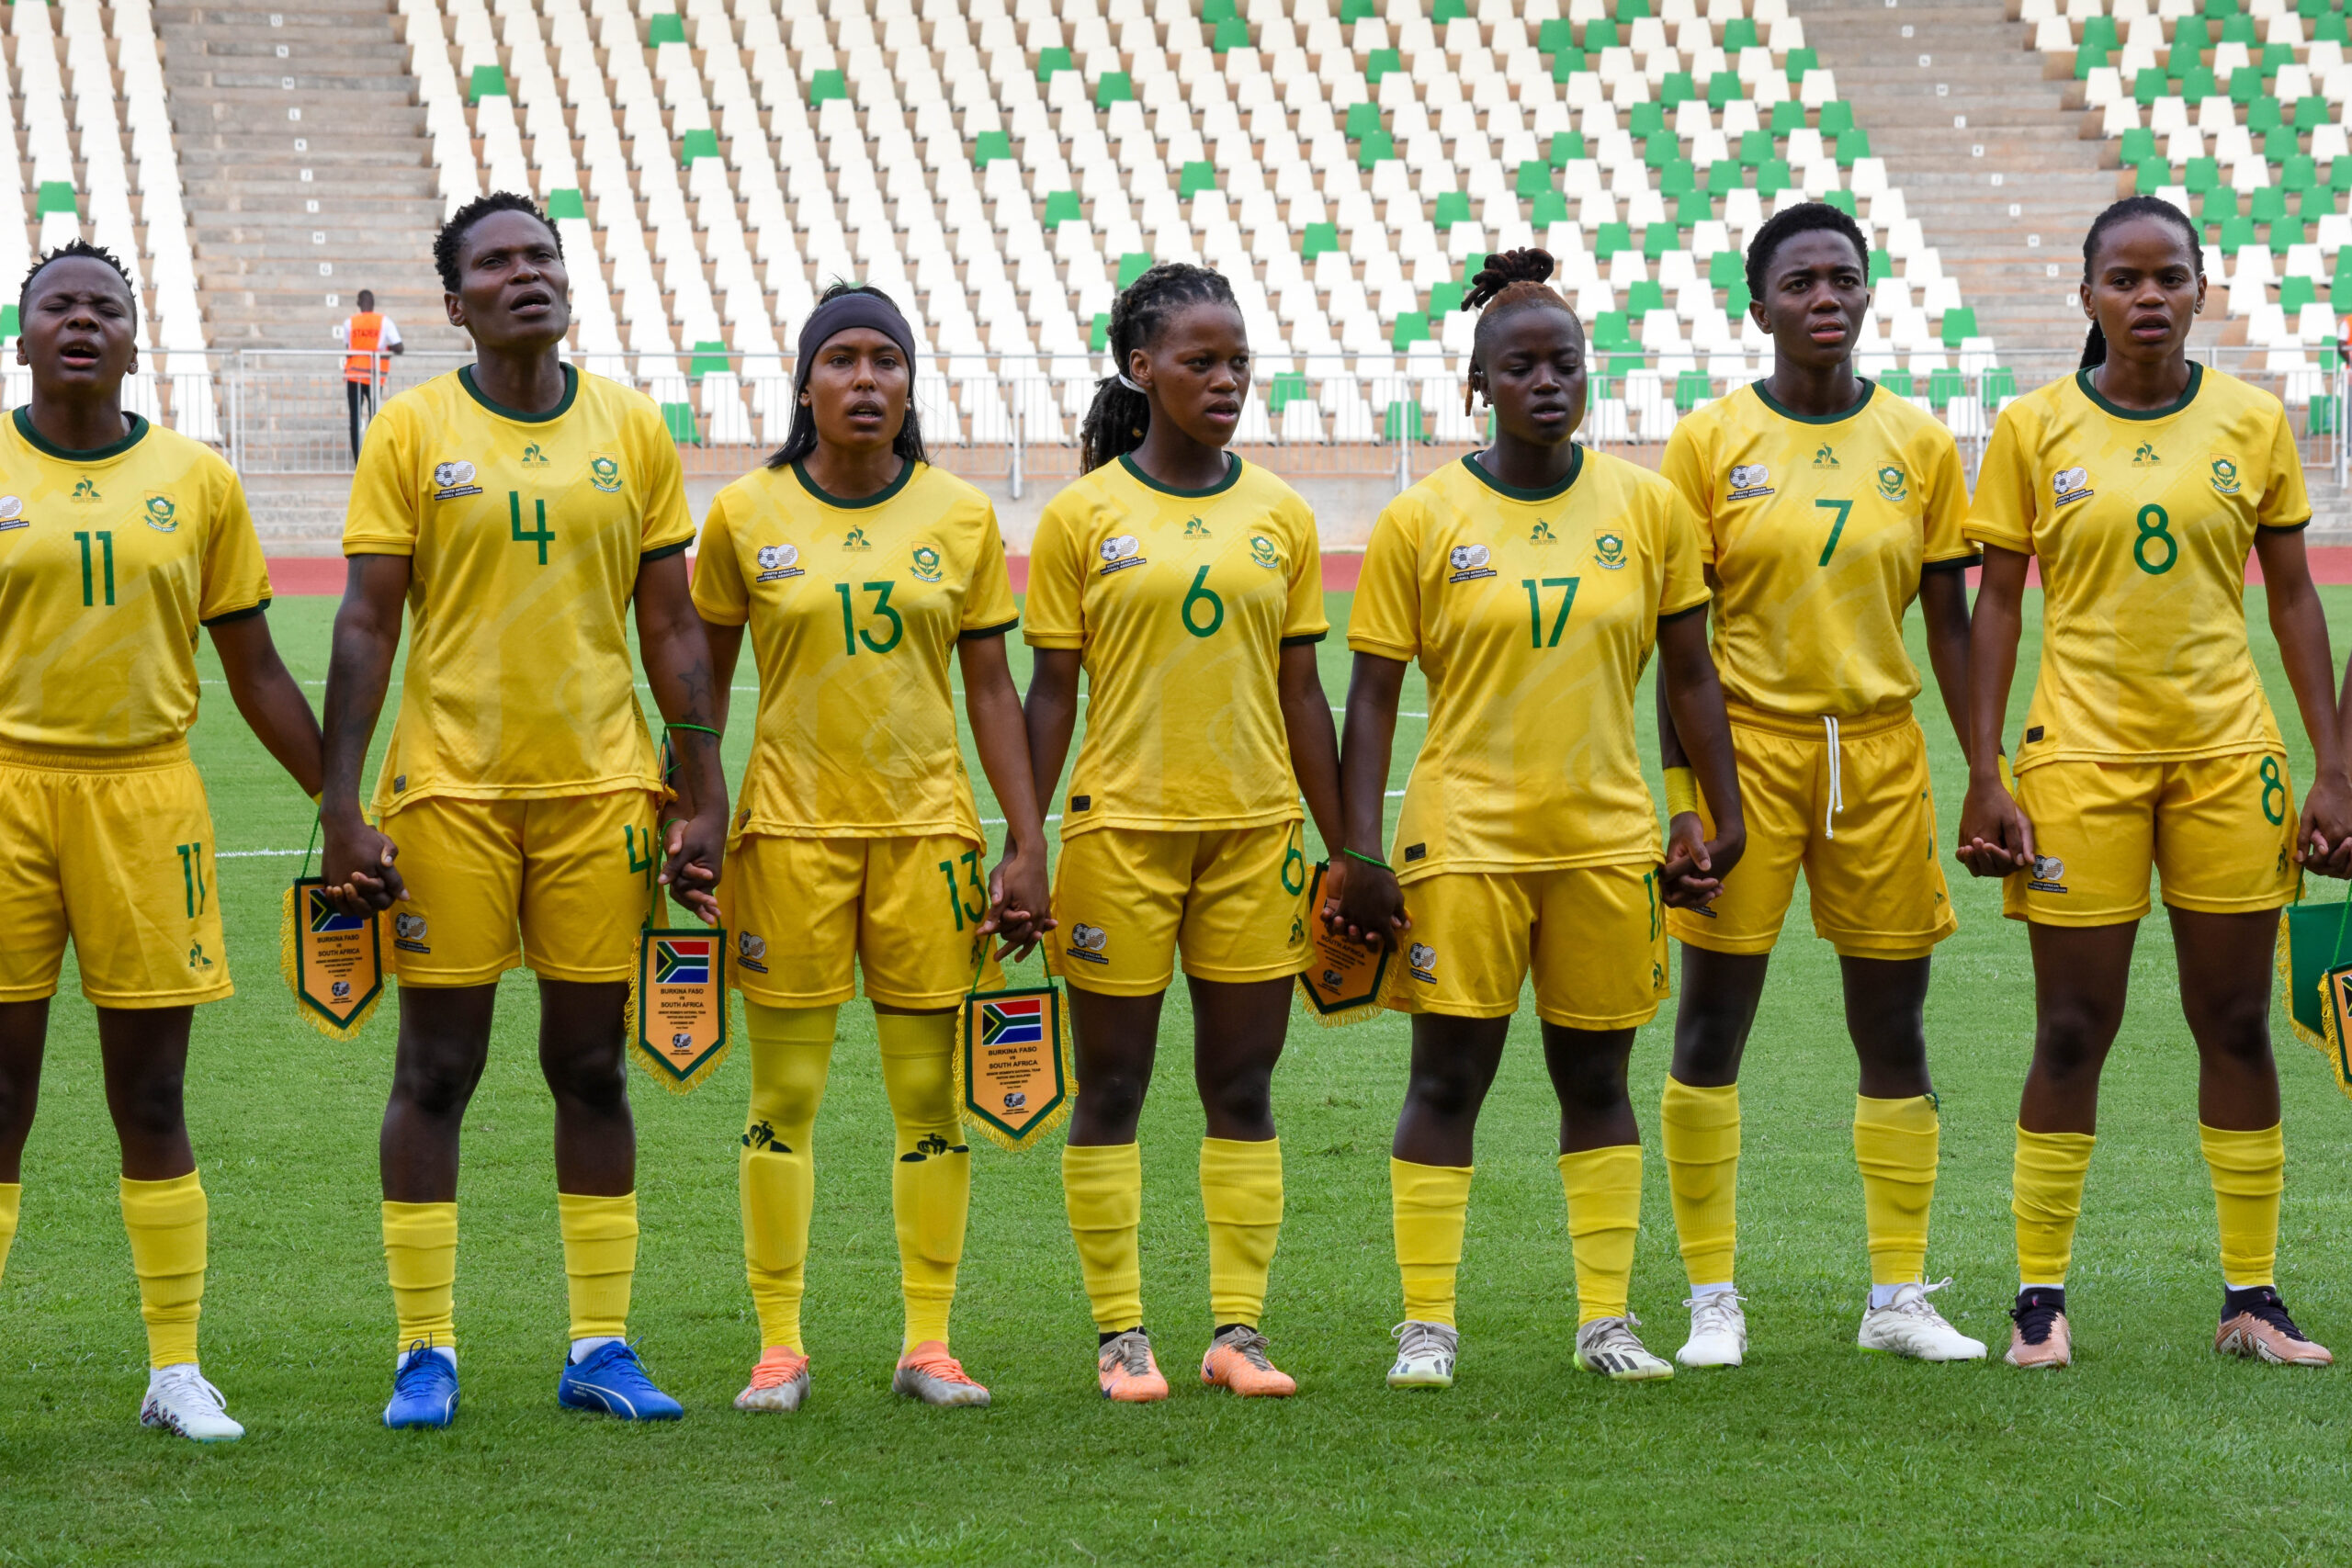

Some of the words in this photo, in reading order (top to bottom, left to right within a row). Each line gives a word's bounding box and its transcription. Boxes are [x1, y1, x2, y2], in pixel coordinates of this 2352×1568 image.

[509, 491, 555, 565] 4
[1815, 499, 1853, 567] 7
[2133, 503, 2178, 575] 8
[74, 531, 115, 606] 11
[1182, 565, 1225, 637] 6
[835, 581, 903, 655] 13
[1521, 576, 1580, 649] 17
[2260, 756, 2285, 826] 8
[176, 841, 207, 919] 11
[624, 824, 653, 891] 4
[939, 850, 986, 931] 13
[1282, 824, 1306, 897] 6
[1342, 944, 1365, 958] AFRICA
[989, 1048, 1018, 1056] BURKINA
